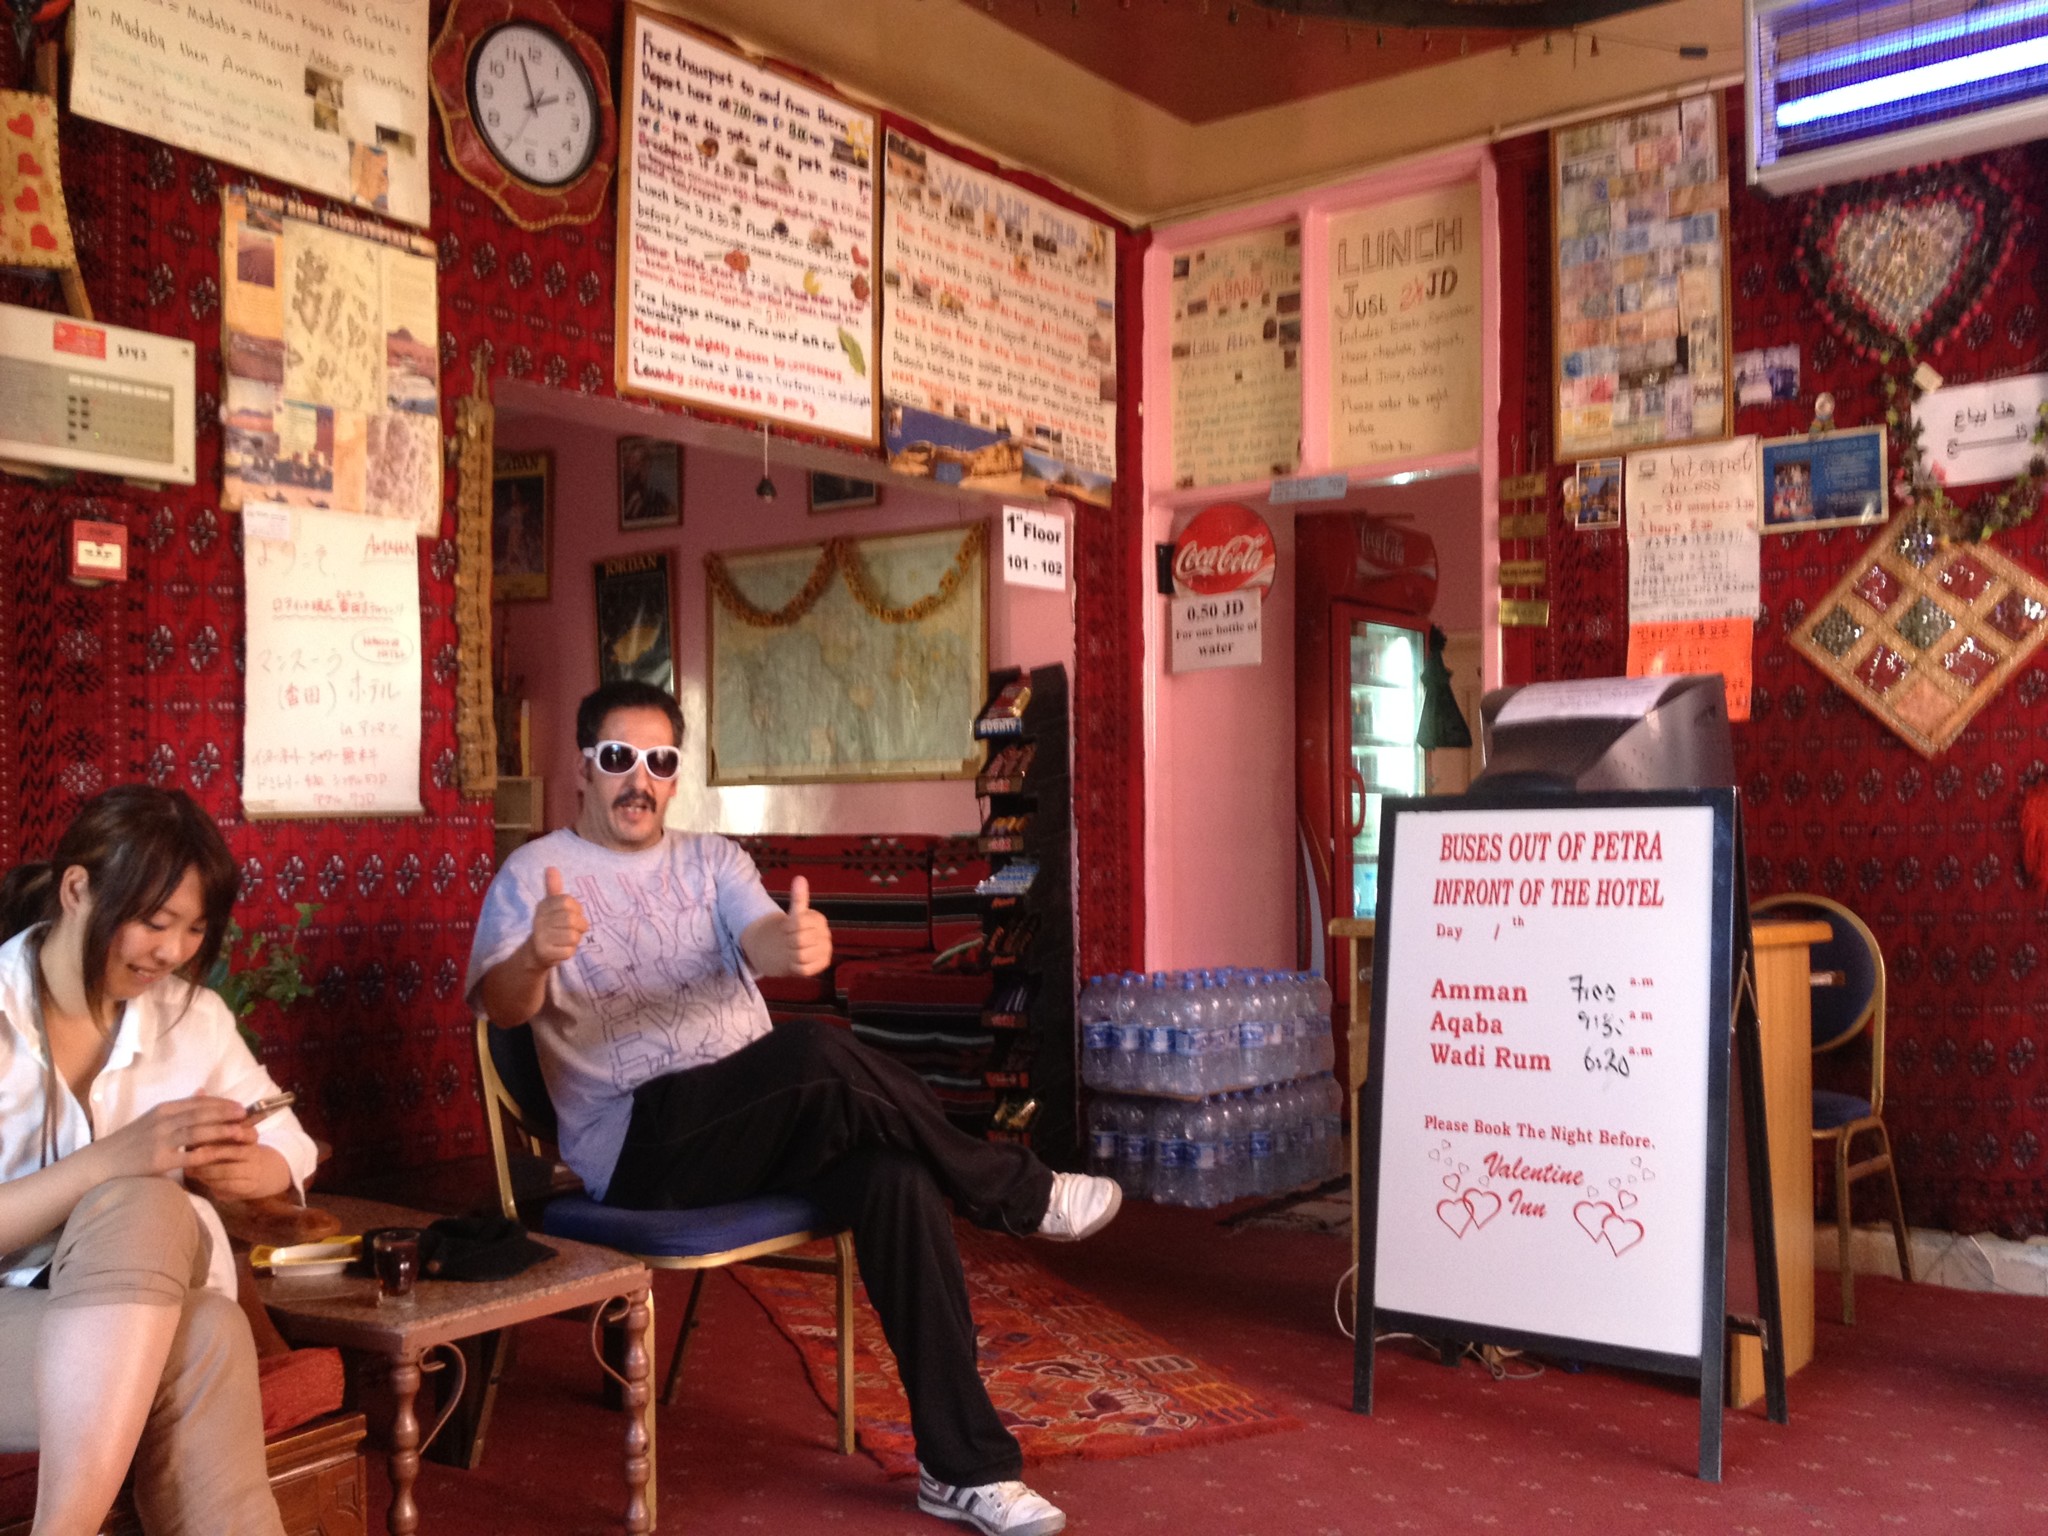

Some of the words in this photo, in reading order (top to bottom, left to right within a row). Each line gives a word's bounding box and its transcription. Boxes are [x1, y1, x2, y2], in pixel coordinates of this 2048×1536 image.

[1338, 217, 1462, 277] LUNCH
[1335, 281, 1387, 321] Just
[1426, 265, 1458, 300] JD
[1023, 521, 1063, 544] Floor
[605, 555, 657, 577] JORDAN
[1007, 554, 1029, 571] 101
[1041, 558, 1063, 576] 102
[1187, 603, 1218, 621] 0.50
[1222, 600, 1244, 617] JD
[1176, 629, 1193, 640] For
[1196, 627, 1213, 638] one
[1216, 622, 1245, 636] bottle
[1247, 621, 1258, 632] of
[1440, 832, 1502, 862] BUSES
[1509, 832, 1551, 862] OUT
[1558, 831, 1586, 861] OF
[1591, 831, 1663, 862] PETRA
[1433, 878, 1514, 905] INFRONT
[1519, 878, 1545, 906] OF
[1551, 878, 1590, 906] THE
[1596, 878, 1664, 907] HOTEL
[1436, 923, 1462, 941] Day
[1512, 915, 1525, 927] th
[1431, 978, 1528, 1002] Amman
[1430, 1011, 1503, 1038] Aqaba
[1430, 1044, 1486, 1067] Wadi
[1495, 1046, 1551, 1071] Rum
[1424, 1114, 1469, 1133] Please
[1474, 1119, 1511, 1137] Book
[1517, 1122, 1546, 1140] The
[1551, 1126, 1593, 1148] Night
[1483, 1150, 1584, 1187] Valentine
[1508, 1188, 1548, 1218] Inn
